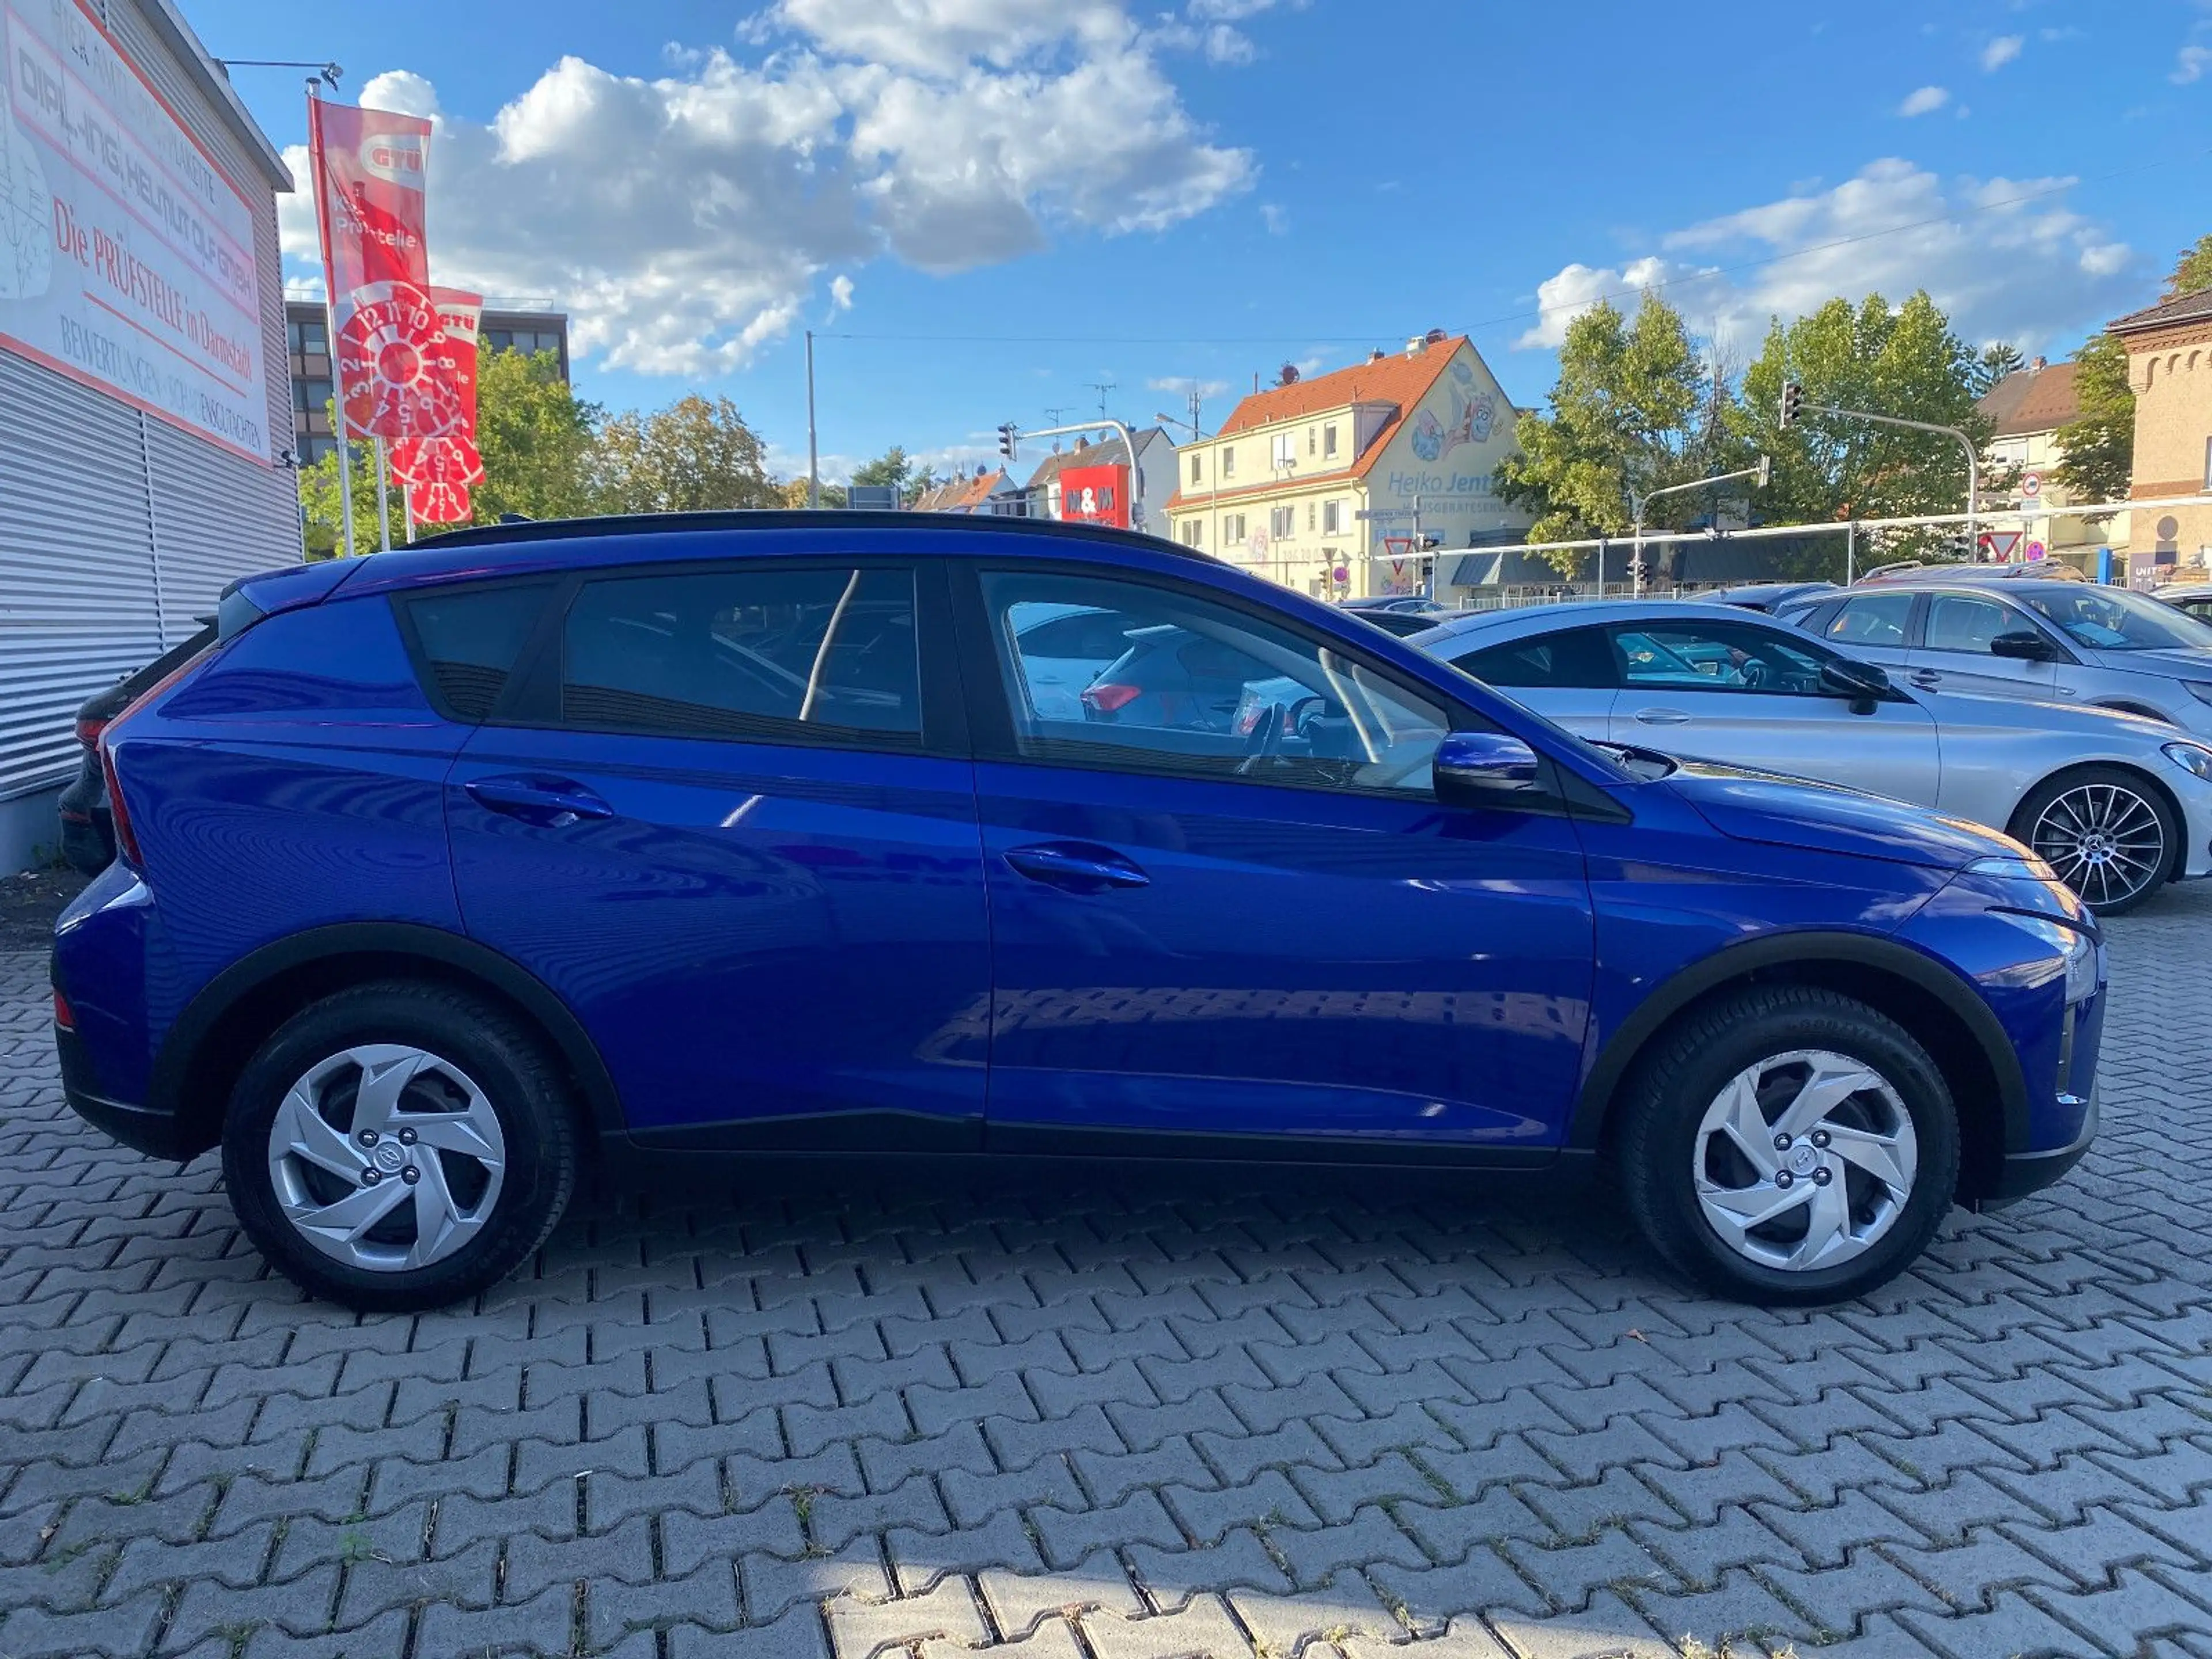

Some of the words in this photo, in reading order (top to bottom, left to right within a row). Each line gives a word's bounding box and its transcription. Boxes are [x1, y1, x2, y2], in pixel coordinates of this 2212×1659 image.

[372, 147, 420, 172] GTÜ
[126, 152, 189, 241] HELMUT
[54, 195, 89, 268] Die
[93, 225, 183, 334] PRÜFSTELLE
[185, 295, 199, 344] in
[199, 309, 252, 383] Darmstadt
[356, 308, 384, 332] 12
[386, 301, 402, 322] 11
[406, 303, 430, 330] 10
[438, 313, 476, 332] GTÜ
[428, 330, 446, 344] 9
[60, 314, 161, 400] BEWERTUNGEN
[340, 357, 361, 373] 2
[437, 355, 456, 370] 8
[350, 381, 370, 399] 3
[376, 401, 391, 418] 4
[397, 403, 411, 426] 5
[1388, 471, 1442, 497] Heiko
[1067, 486, 1115, 514] M&M
